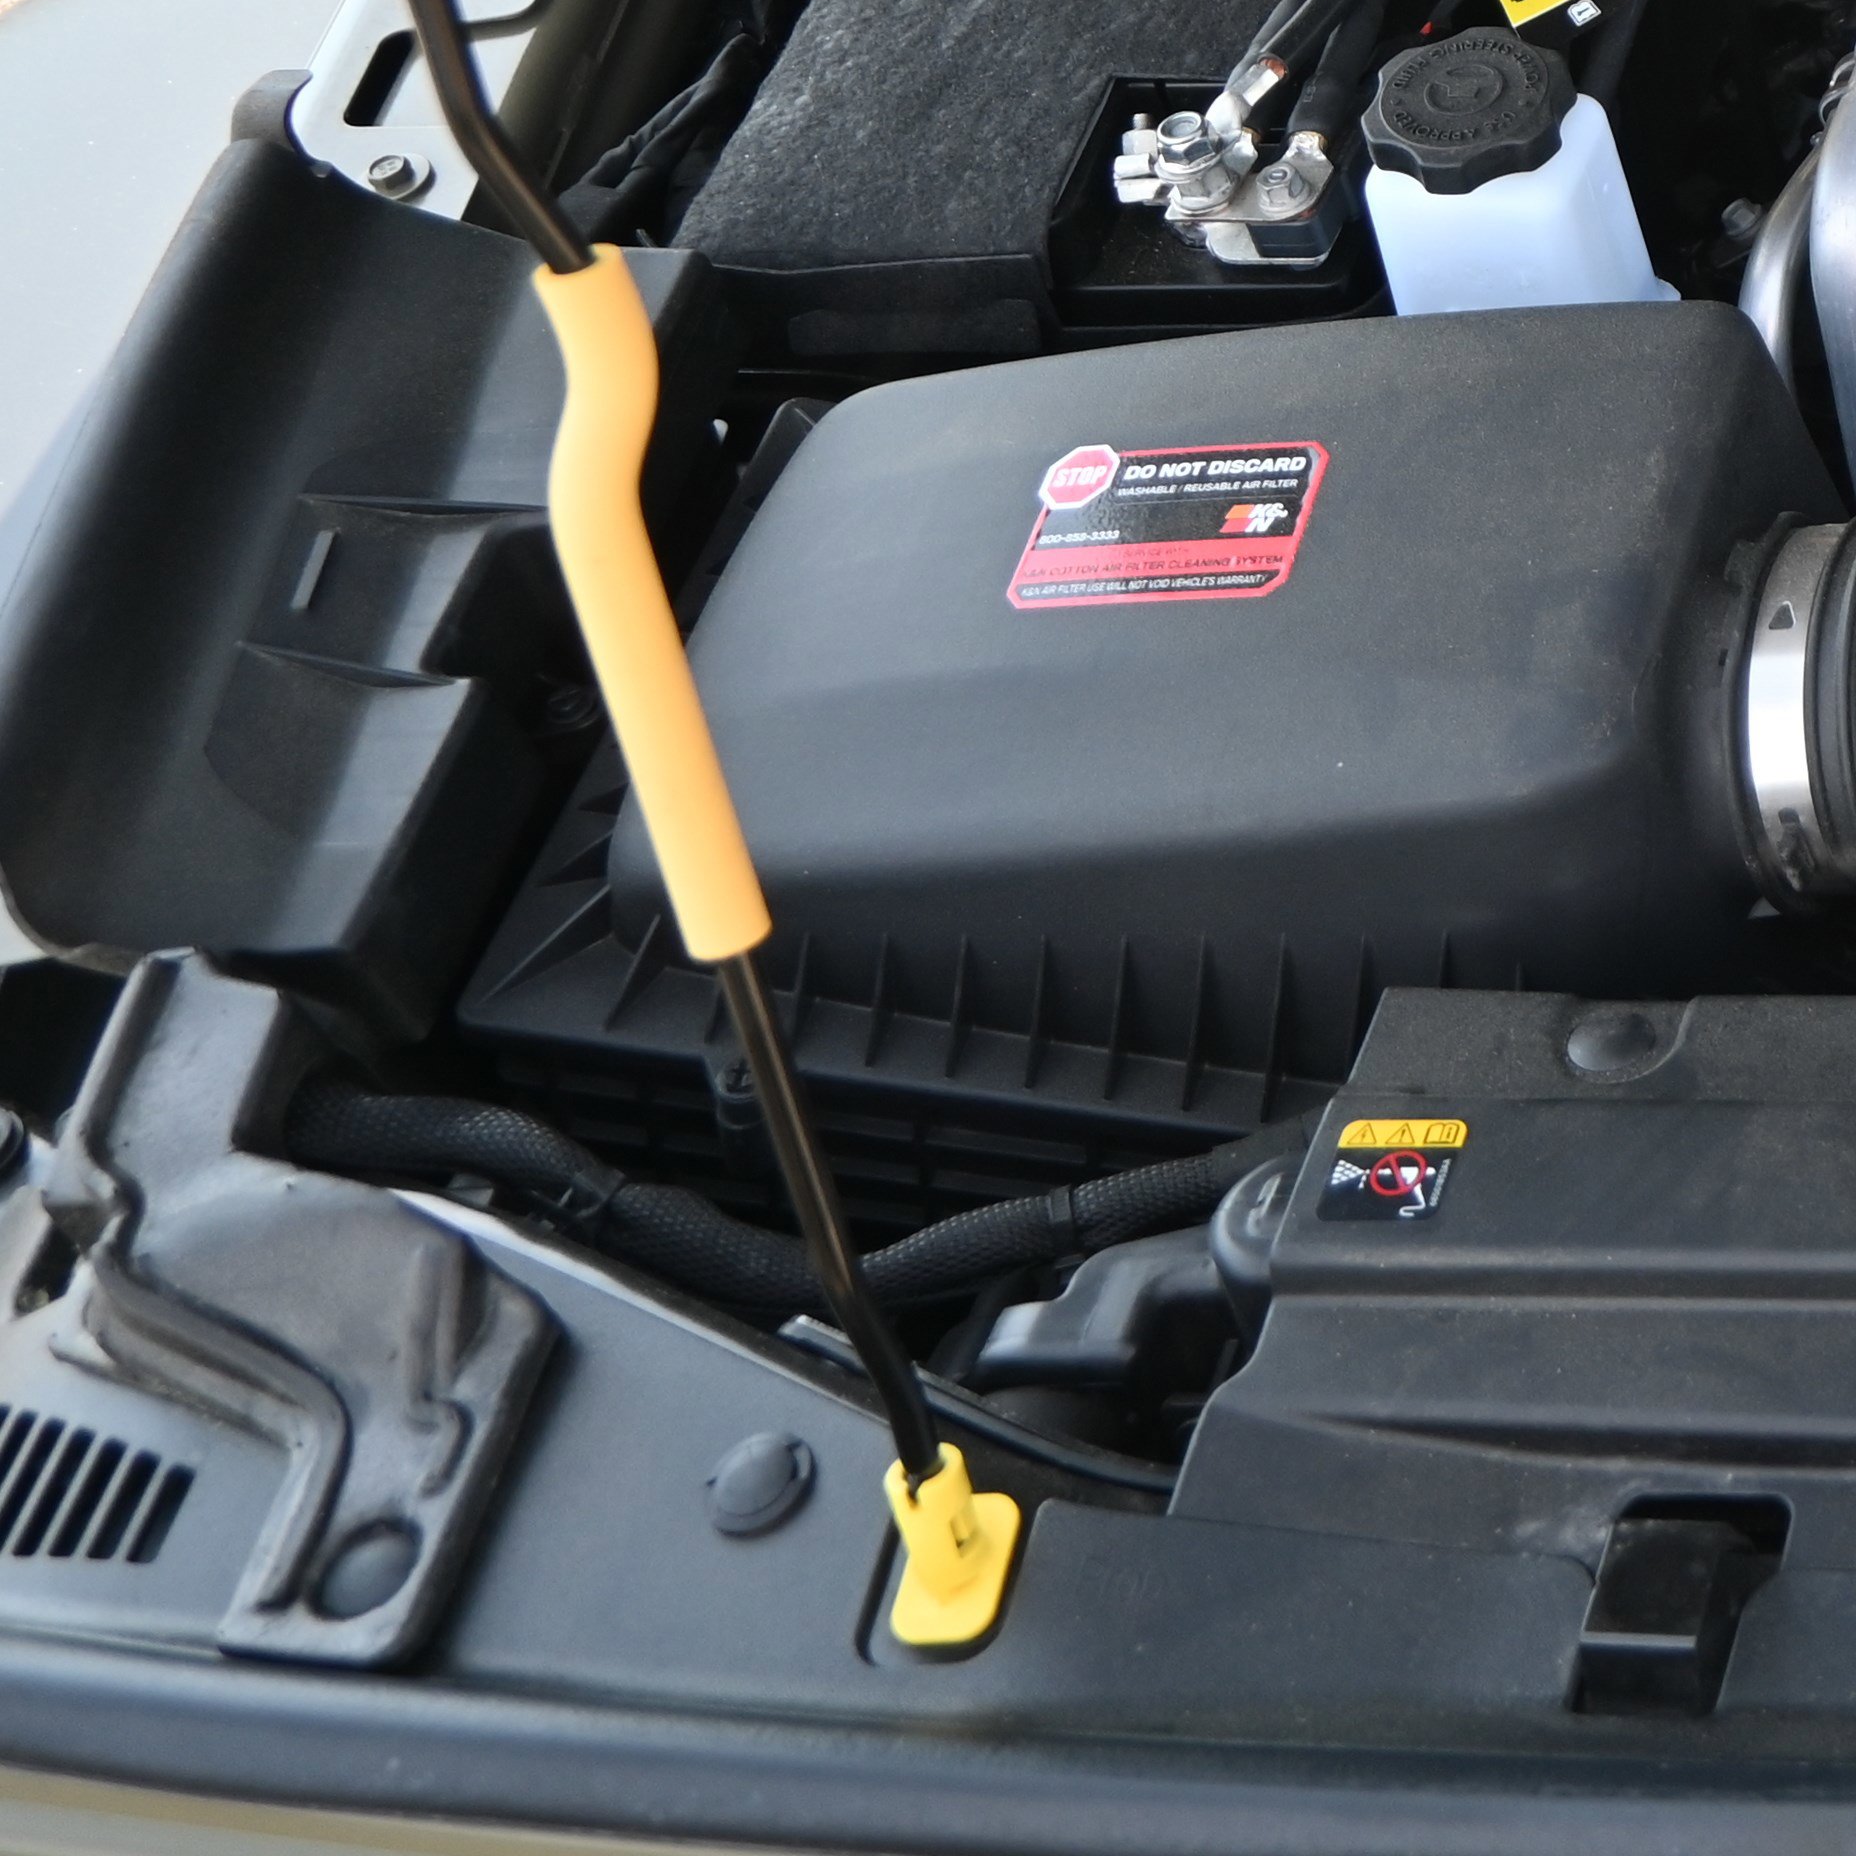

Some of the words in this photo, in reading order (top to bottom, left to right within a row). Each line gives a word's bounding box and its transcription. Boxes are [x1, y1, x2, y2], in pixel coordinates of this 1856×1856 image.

[1052, 465, 1108, 487] STOP
[1124, 465, 1157, 480] DO
[1158, 461, 1206, 478] NOT
[1207, 456, 1307, 475] DISCARD
[1118, 484, 1176, 496] WASHABLE
[1184, 481, 1241, 493] REUSABLE
[1242, 480, 1261, 489] AIR
[1262, 478, 1299, 488] FILTER
[1101, 562, 1122, 571] AIR
[1125, 561, 1165, 571] FILTER
[1168, 558, 1232, 569] CLEANING
[1235, 555, 1283, 566] SYSTEM
[1041, 585, 1057, 594] AIR
[1057, 583, 1086, 593] FILTER
[1087, 582, 1106, 592] USE
[1106, 581, 1127, 591] WILL
[1128, 580, 1149, 590] NOT
[1150, 578, 1170, 588] VOID
[1217, 574, 1268, 585] WARRANTY
